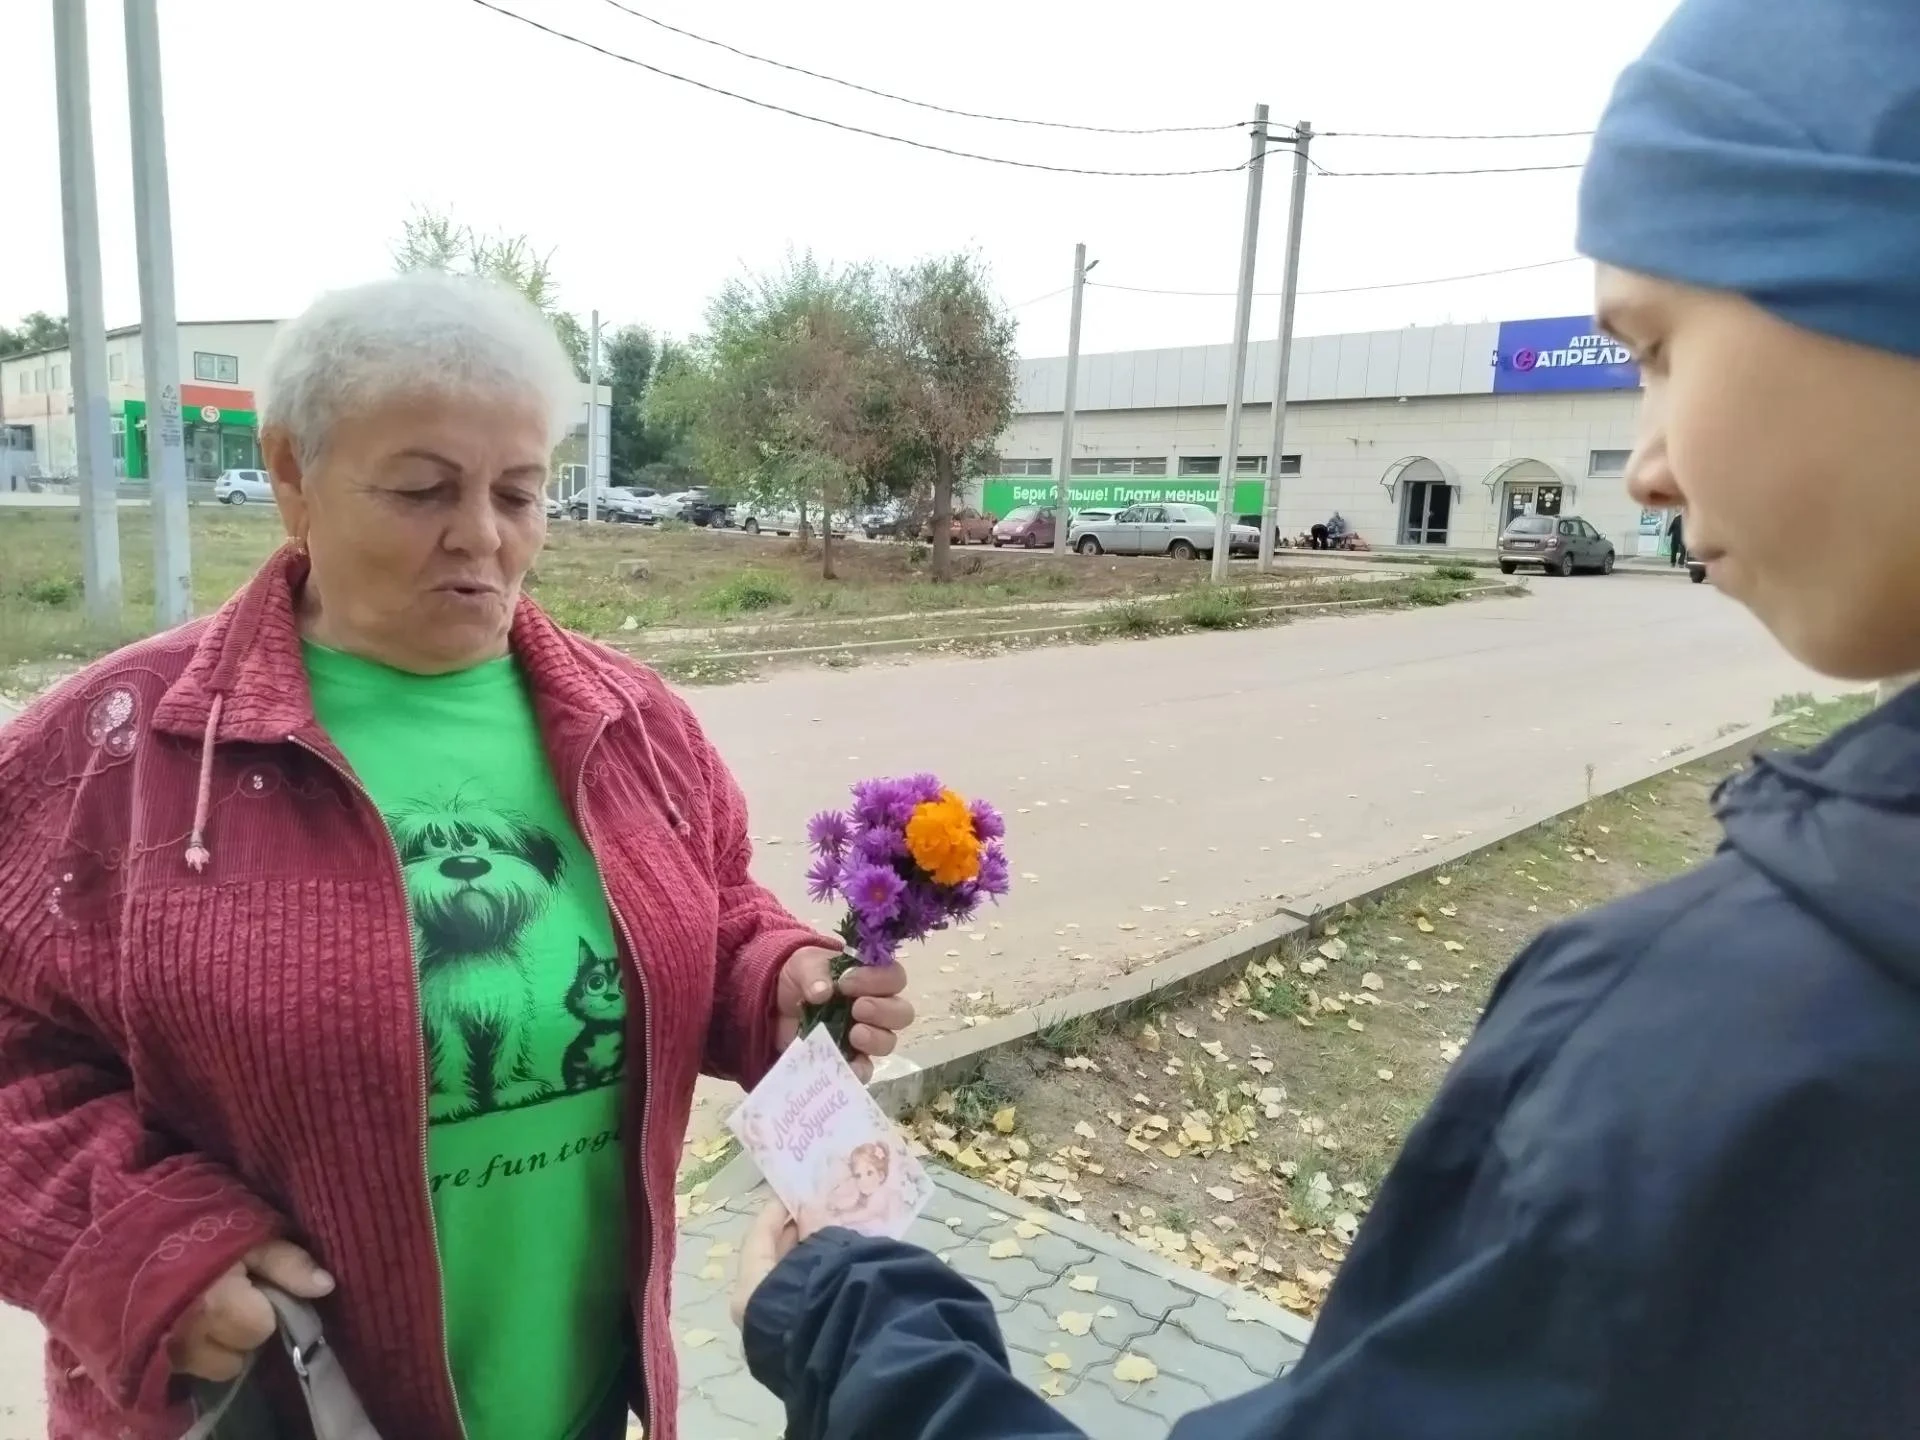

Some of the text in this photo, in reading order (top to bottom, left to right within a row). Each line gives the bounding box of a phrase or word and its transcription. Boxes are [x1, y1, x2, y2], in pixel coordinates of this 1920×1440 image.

[1535, 347, 1631, 368] АПРЕЛЬ
[1569, 335, 1619, 348] АПТЕК
[1013, 486, 1046, 504] Бери
[1049, 484, 1109, 501] бльше!
[1114, 487, 1161, 501] Плати
[771, 1068, 832, 1150] Любимой
[787, 1089, 848, 1162] бабушке
[429, 1128, 620, 1193] re fun tog
